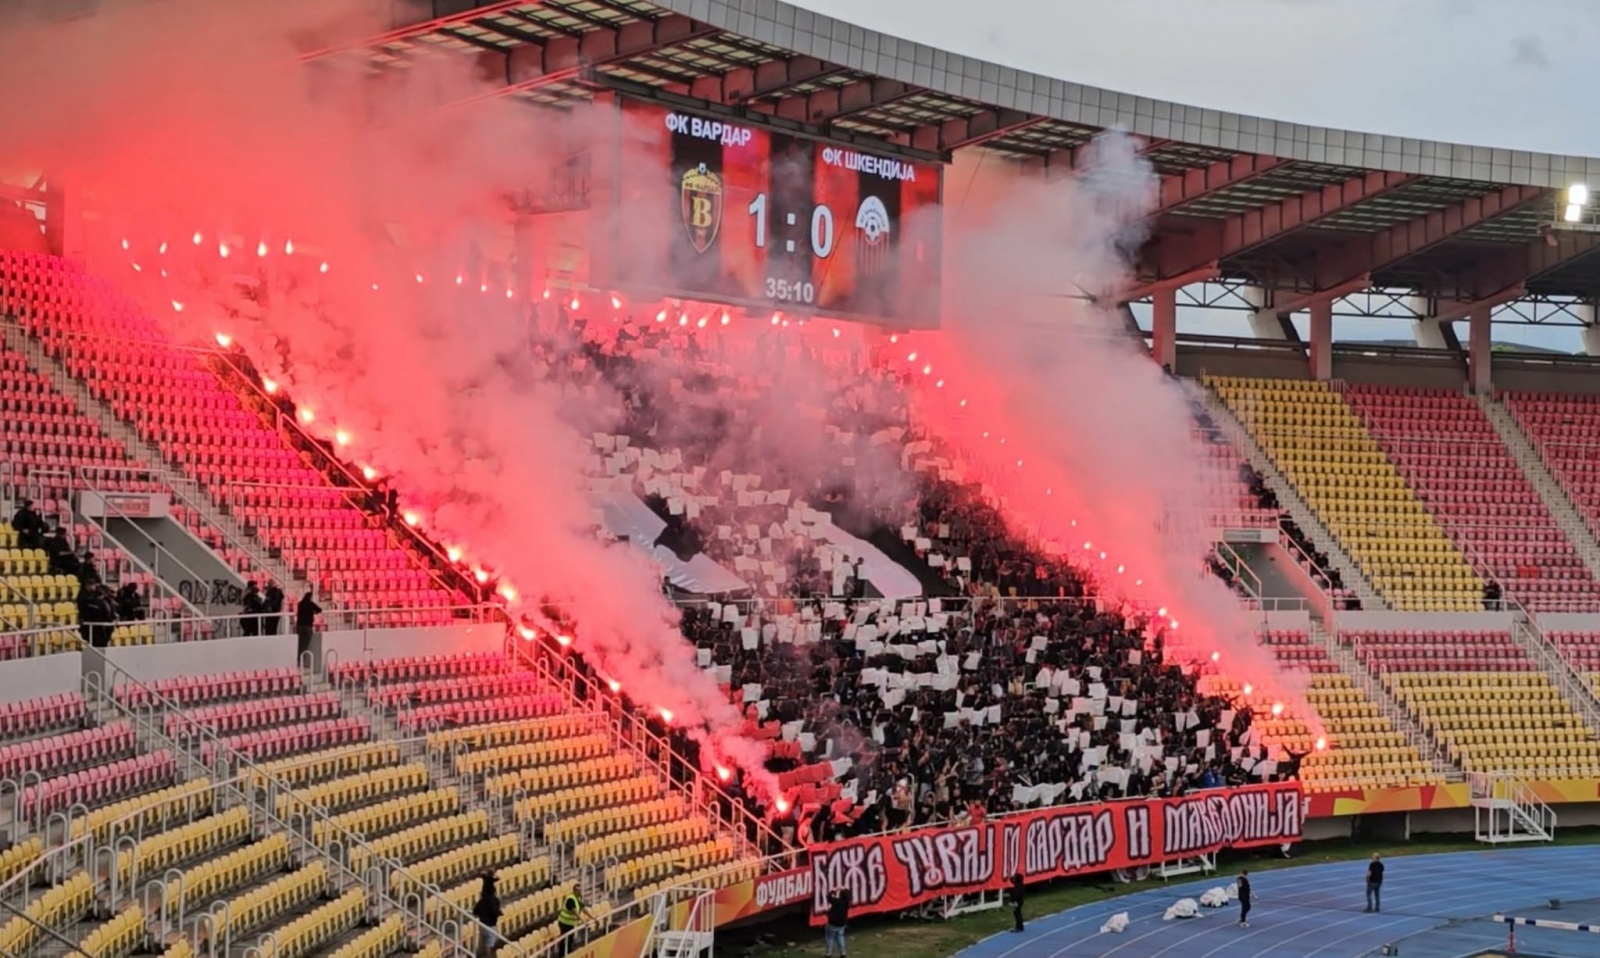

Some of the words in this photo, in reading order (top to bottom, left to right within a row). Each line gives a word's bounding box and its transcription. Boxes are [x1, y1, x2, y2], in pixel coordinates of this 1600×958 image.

[665, 113, 689, 135] ФК
[691, 117, 751, 147] ВАРДАР
[822, 147, 842, 167] ФК
[845, 151, 915, 182] ШКЕНДИЈА
[765, 277, 814, 303] 35:10
[894, 827, 995, 896] ЧУВАЈ
[1002, 823, 1021, 878] ГО
[1026, 808, 1114, 872] ВАРДАР
[1163, 791, 1299, 854] МАКЕДОНИЈА
